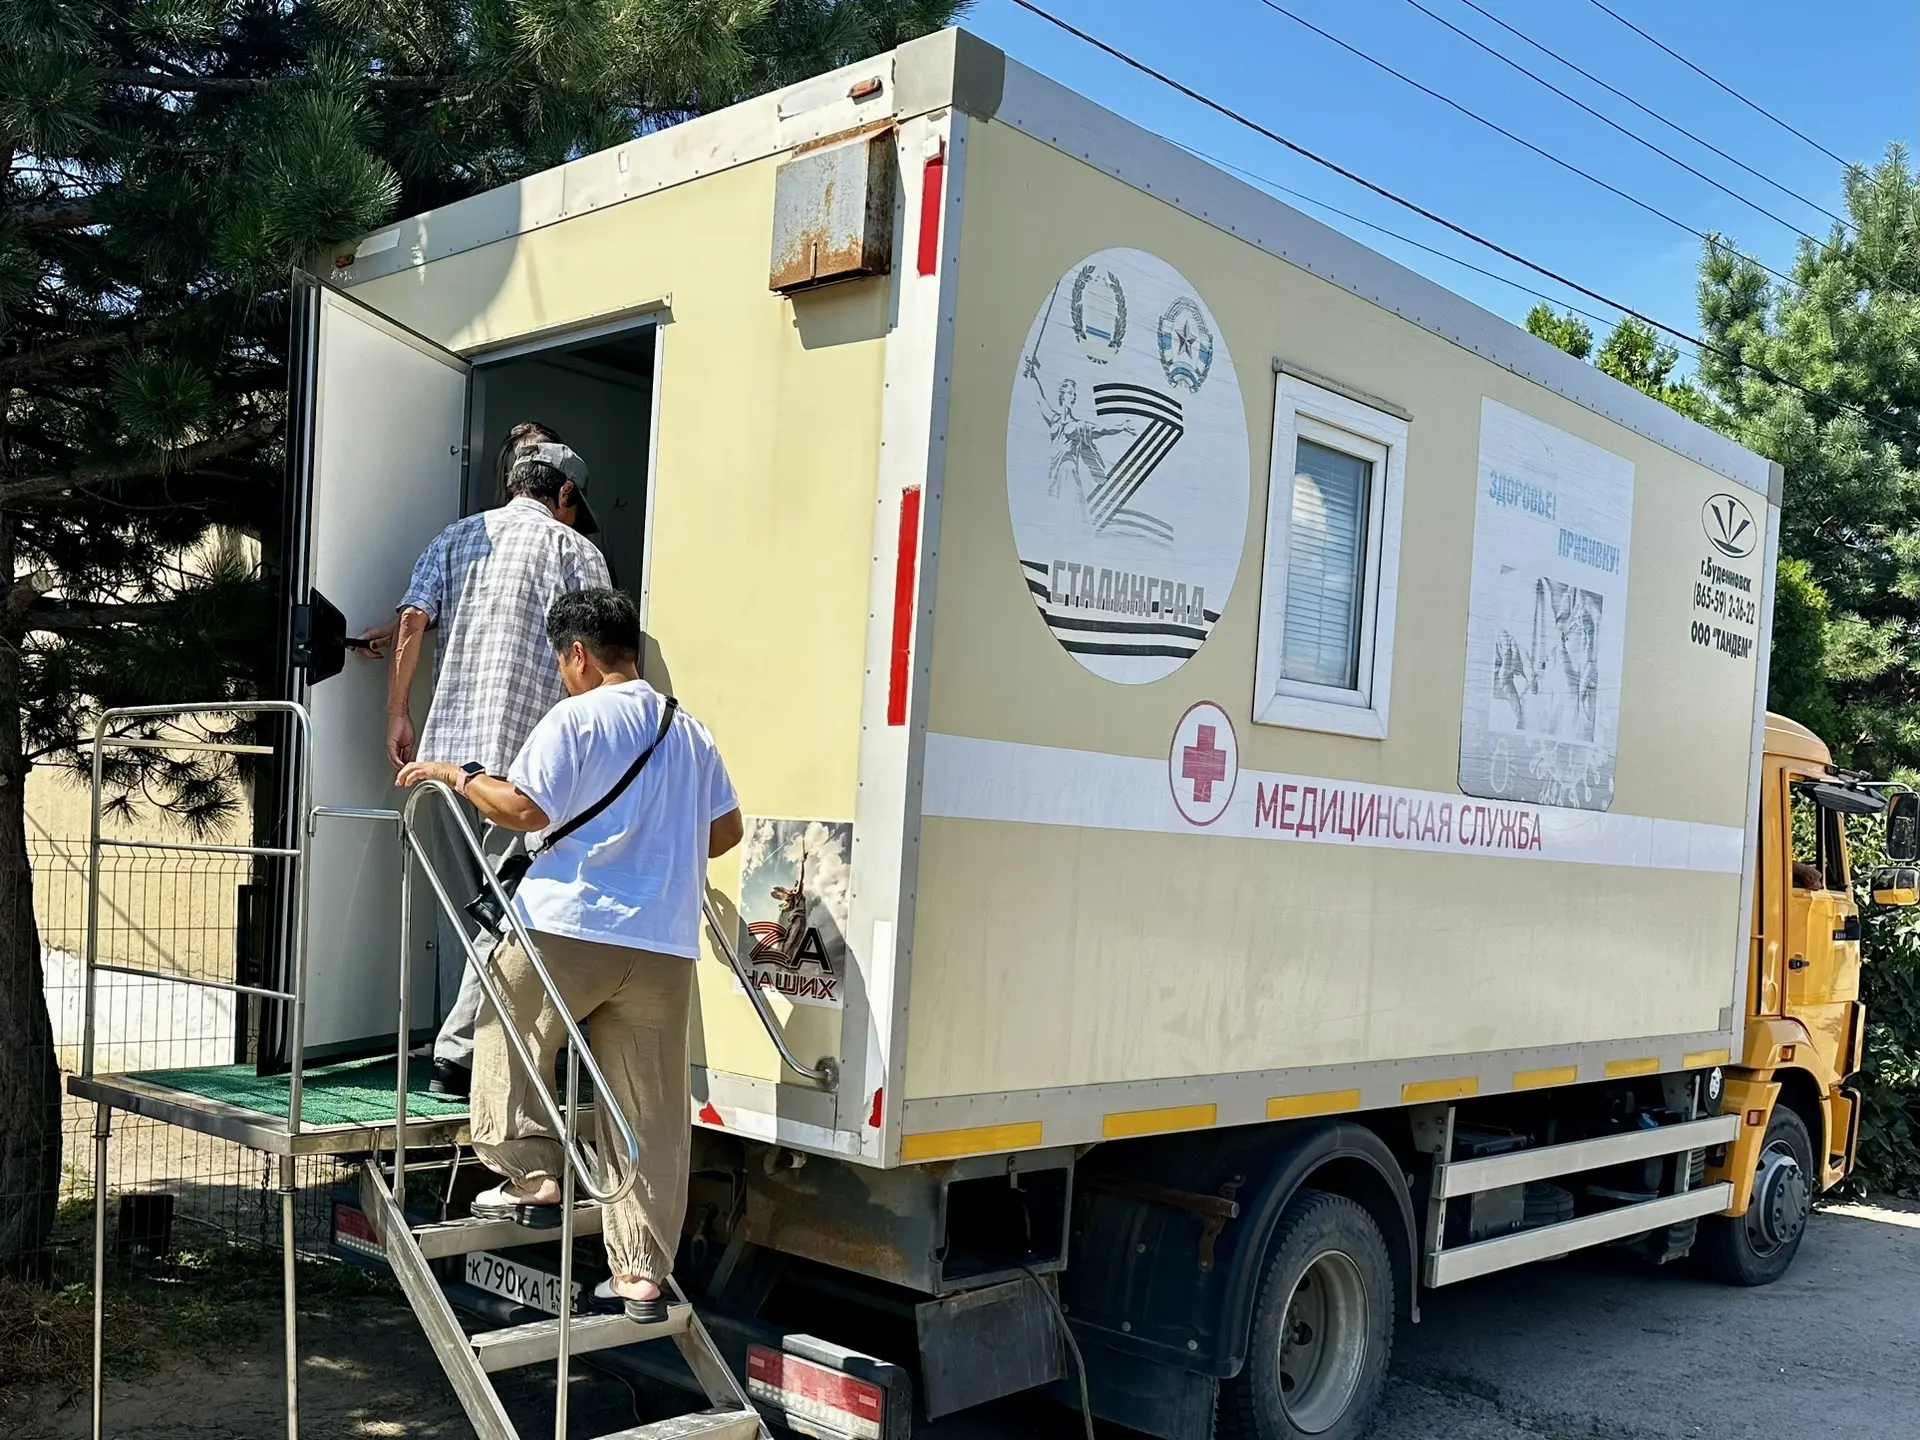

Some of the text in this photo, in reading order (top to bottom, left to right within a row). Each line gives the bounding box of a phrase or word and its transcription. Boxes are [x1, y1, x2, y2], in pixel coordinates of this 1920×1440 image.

[1489, 469, 1557, 521] ЗДОРОВЬЕ!
[1558, 527, 1620, 576] ПРИВИВКУ!
[1051, 559, 1205, 626] СТАЛИНГРАД
[1692, 580, 1756, 625] (865-59) 2-36-22
[1691, 620, 1711, 647] ООО
[1254, 781, 1542, 851] МЕДИЦИНСКАЯ СЛУЖБА
